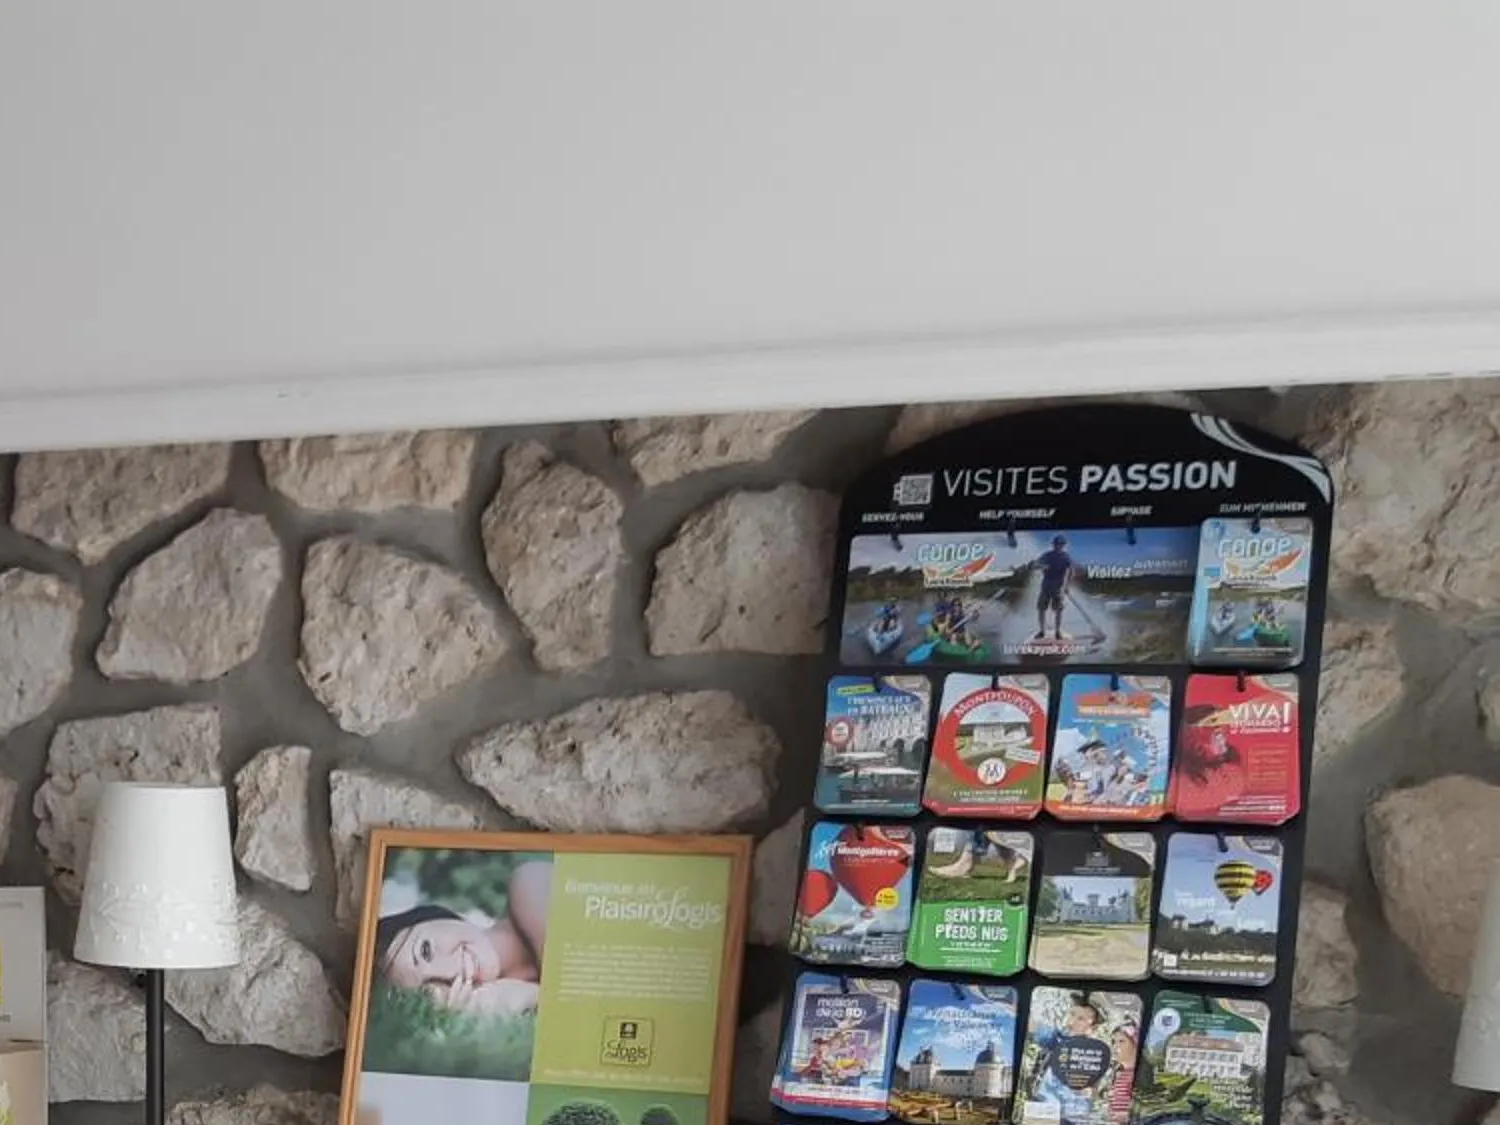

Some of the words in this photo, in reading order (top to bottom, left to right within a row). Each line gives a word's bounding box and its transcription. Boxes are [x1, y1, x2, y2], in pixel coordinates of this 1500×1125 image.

[943, 465, 1068, 497] VISITES
[1079, 460, 1237, 493] PASSION
[981, 925, 1009, 942] NUS
